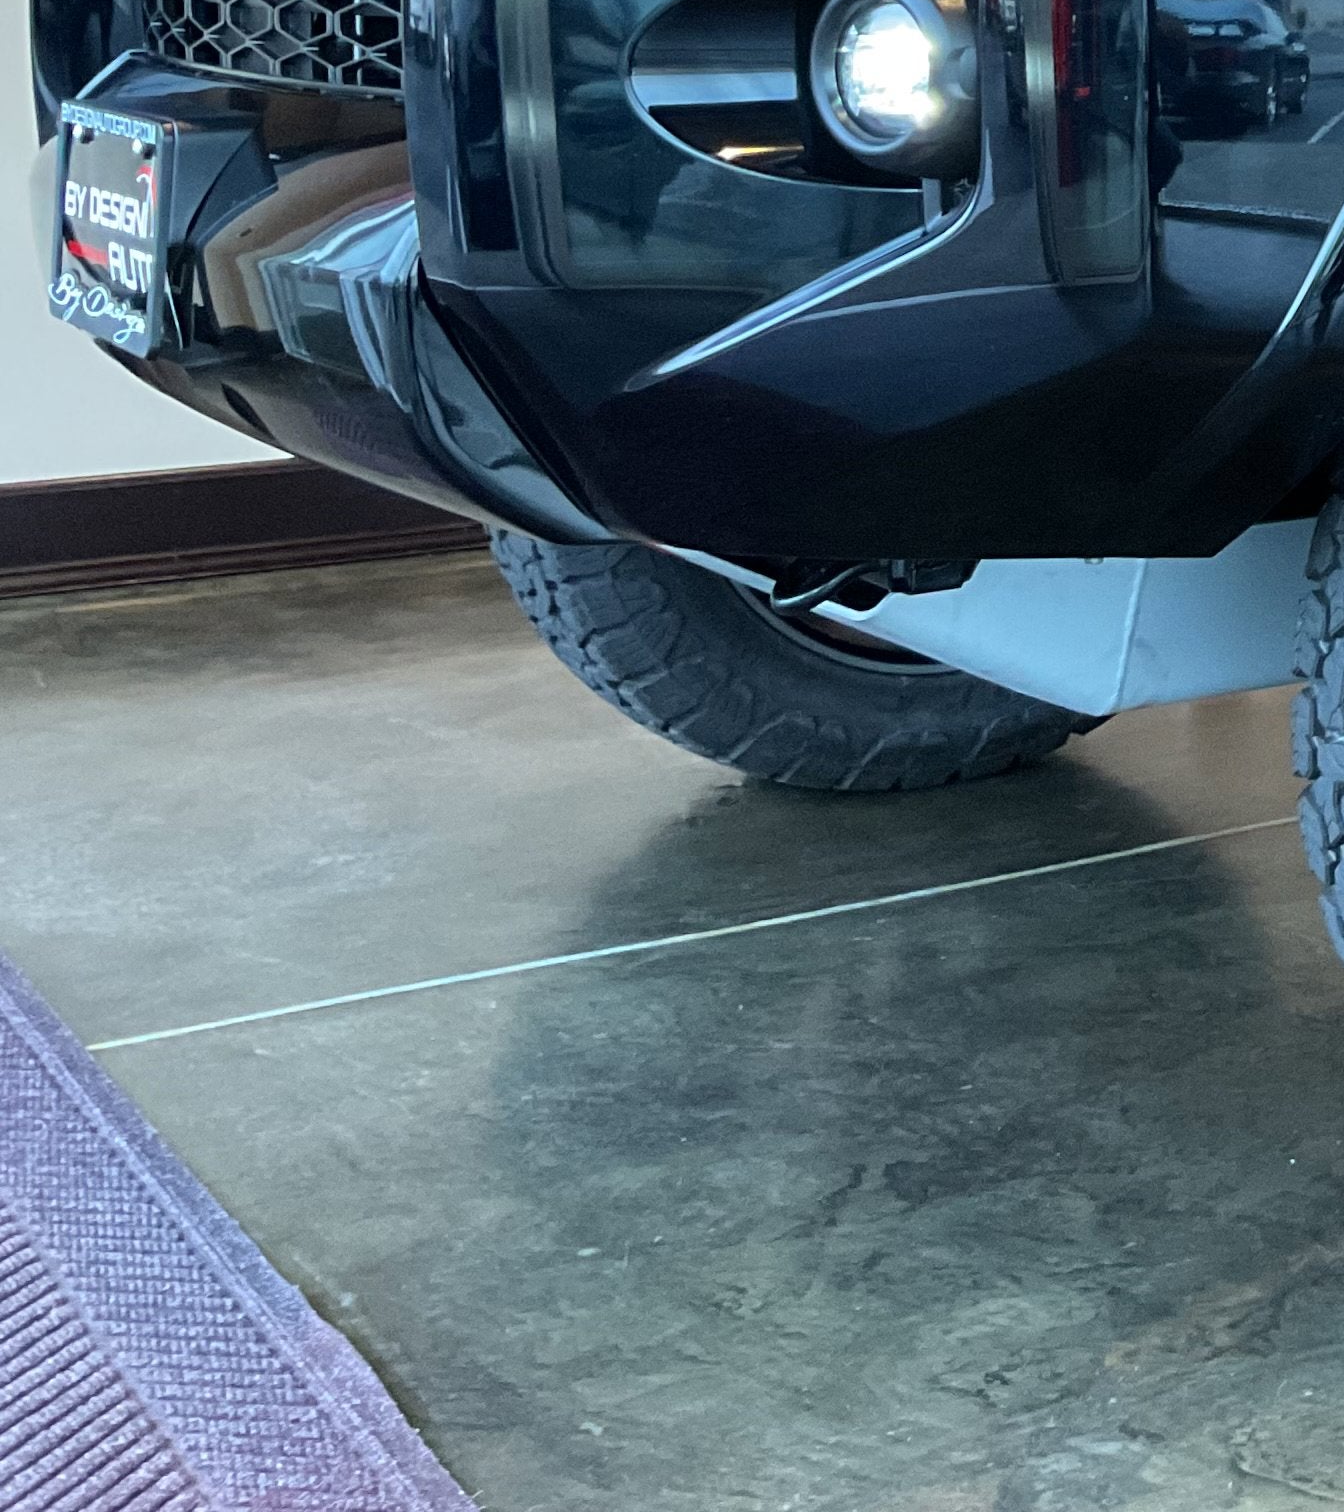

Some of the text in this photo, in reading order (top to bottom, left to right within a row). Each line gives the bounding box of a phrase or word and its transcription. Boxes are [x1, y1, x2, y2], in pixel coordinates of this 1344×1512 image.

[64, 180, 148, 239] BY DESIGN
[48, 272, 83, 322] By
